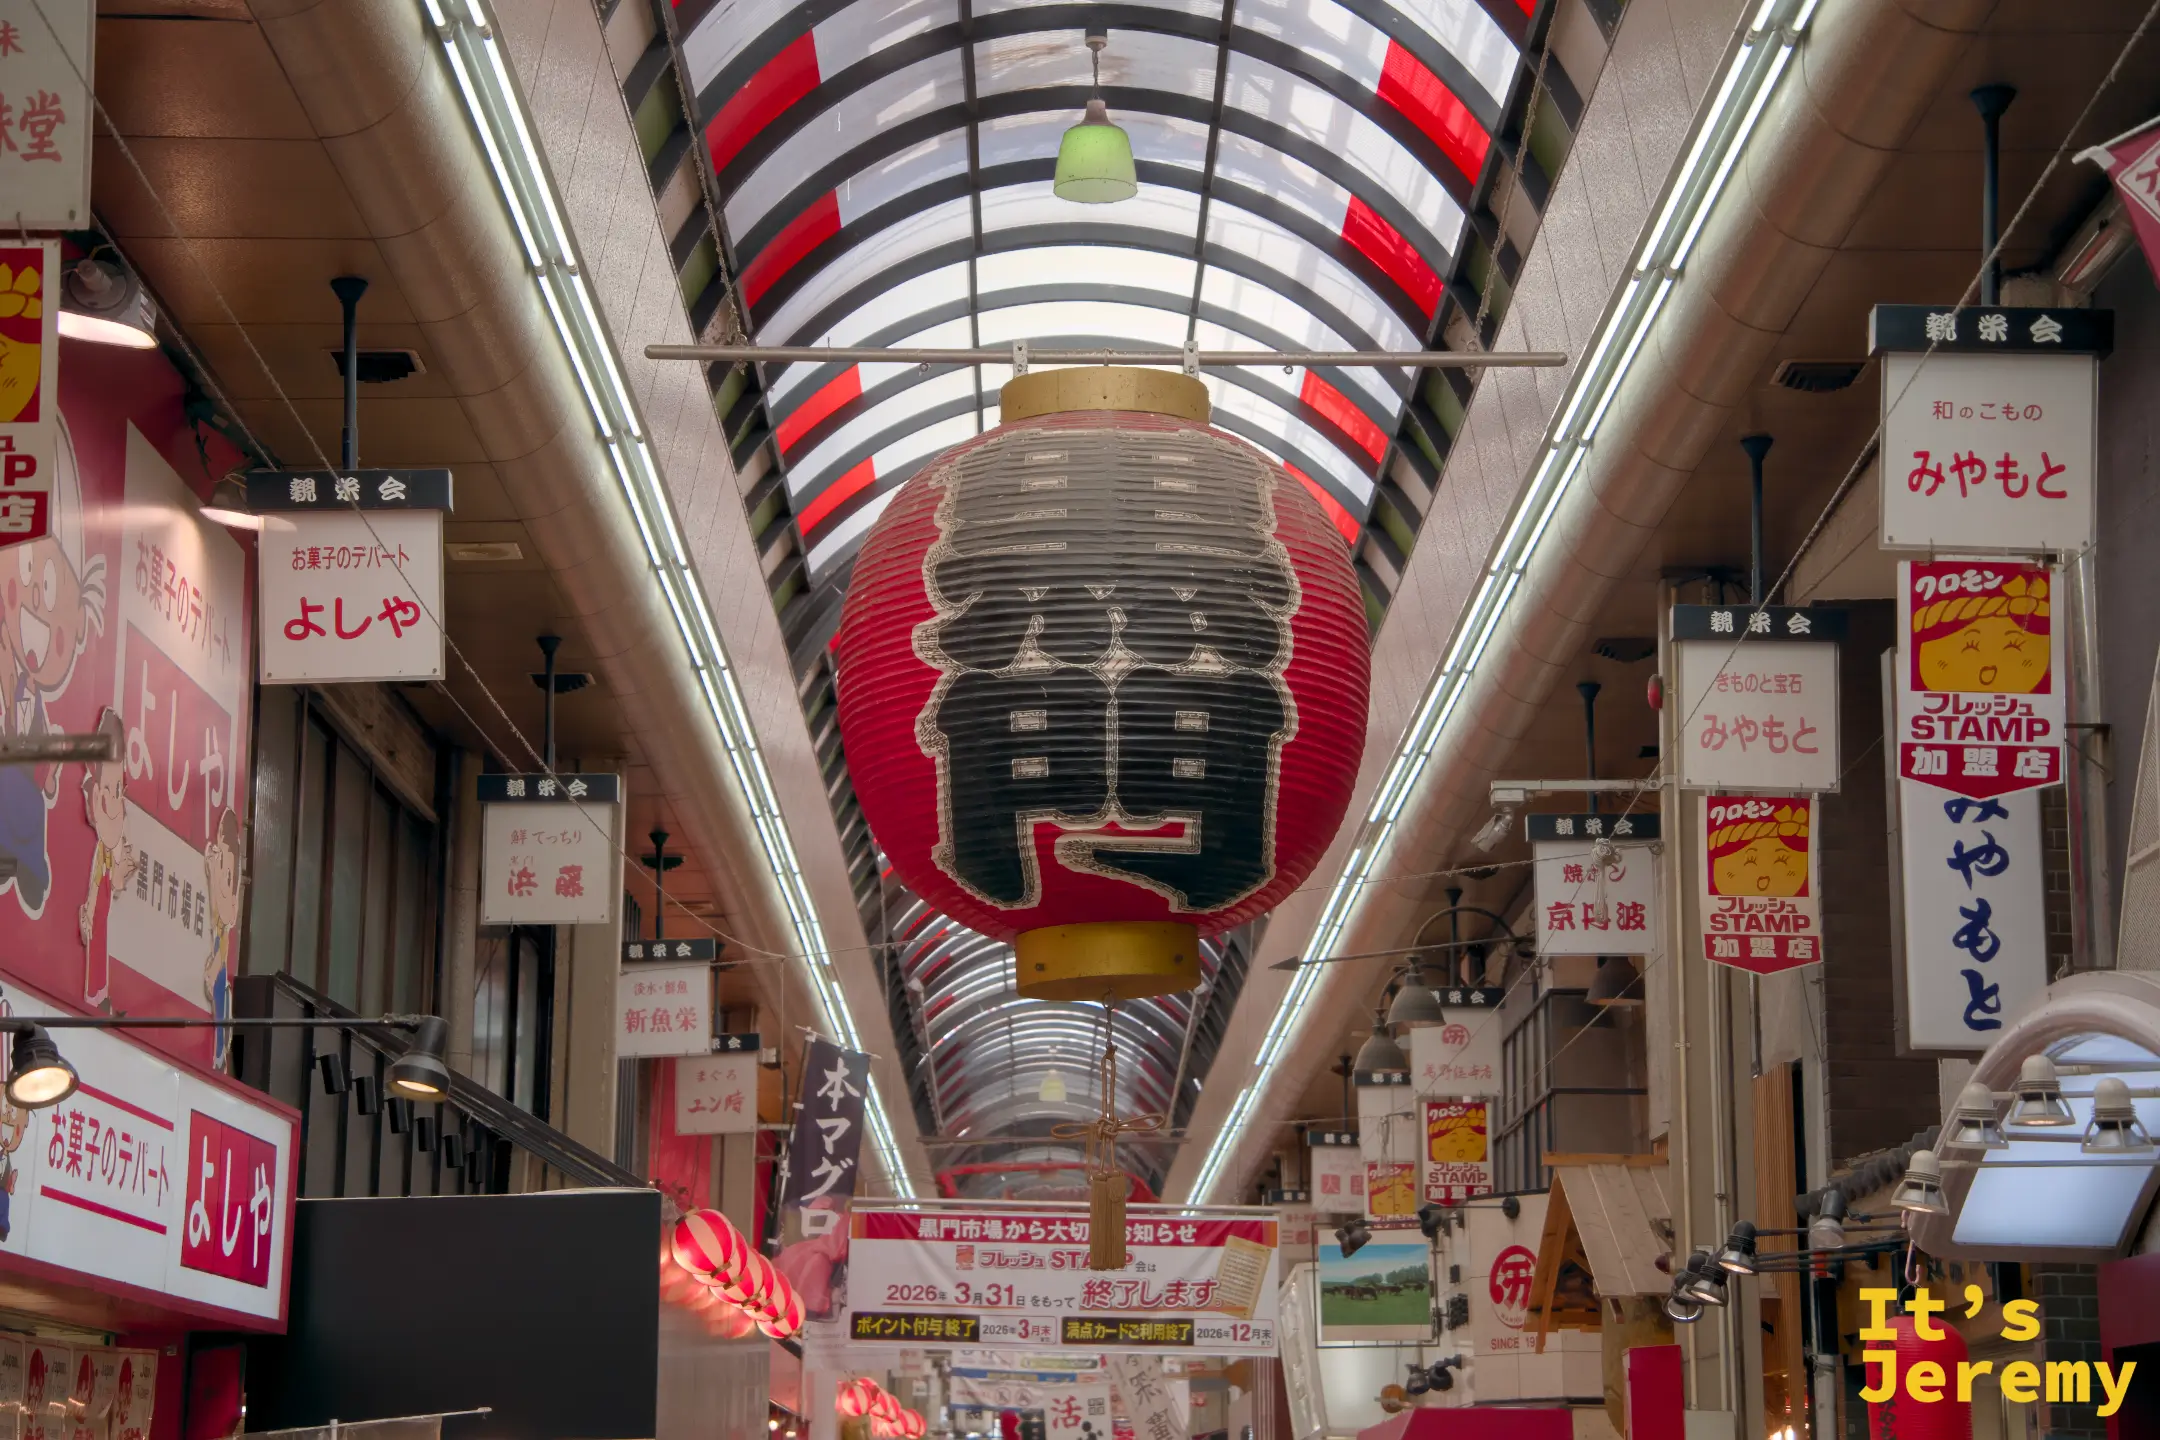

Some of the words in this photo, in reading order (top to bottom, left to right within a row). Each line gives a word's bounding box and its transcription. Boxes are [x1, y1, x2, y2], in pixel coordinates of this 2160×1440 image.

[1933, 400, 2043, 421] 和のこもの
[1908, 451, 2067, 498] みやもと
[292, 543, 410, 571] お菓子のデパート
[1915, 569, 2004, 601] クロモン
[135, 532, 231, 675] お菓子のデパート
[284, 596, 421, 641] よしや
[910, 428, 1303, 913] 黒門
[1717, 672, 1803, 694] きものと宝石
[1922, 693, 2034, 716] フレッシュ
[1700, 714, 1818, 754] みやもと
[1911, 715, 2050, 742] STAMP
[127, 659, 225, 840] よしや
[1911, 746, 2051, 779] 加盟店
[1709, 800, 1775, 825] クロモン
[136, 850, 206, 938] 黒門市場店
[1718, 897, 1798, 913] フレッシュ
[1546, 901, 1647, 931] 京丹波
[1710, 914, 1811, 933] STAMP
[1712, 936, 1812, 959] 加盟店
[624, 1006, 698, 1034] 新魚栄
[696, 1069, 738, 1082] まぐろ
[1428, 1105, 1468, 1121] クロモン
[49, 1103, 169, 1207] お菓子のデパート
[799, 1056, 861, 1238] 本マグロ
[1428, 1172, 1488, 1184] STAMP
[1433, 1161, 1480, 1172] フレッシュ
[189, 1135, 271, 1269] よしや
[1429, 1186, 1492, 1200] 加盟店
[918, 1217, 1197, 1244] 黒門市場から大切知らせ
[979, 1250, 1045, 1270] フレッシュ
[1050, 1249, 1135, 1271] STP
[1135, 1261, 1157, 1272] 会は
[856, 1316, 976, 1338] ポイント付与終了
[1067, 1321, 1192, 1342] 満点カードご利用終了
[1490, 1338, 1520, 1350] SINCE
[1050, 1395, 1083, 1429] 活
